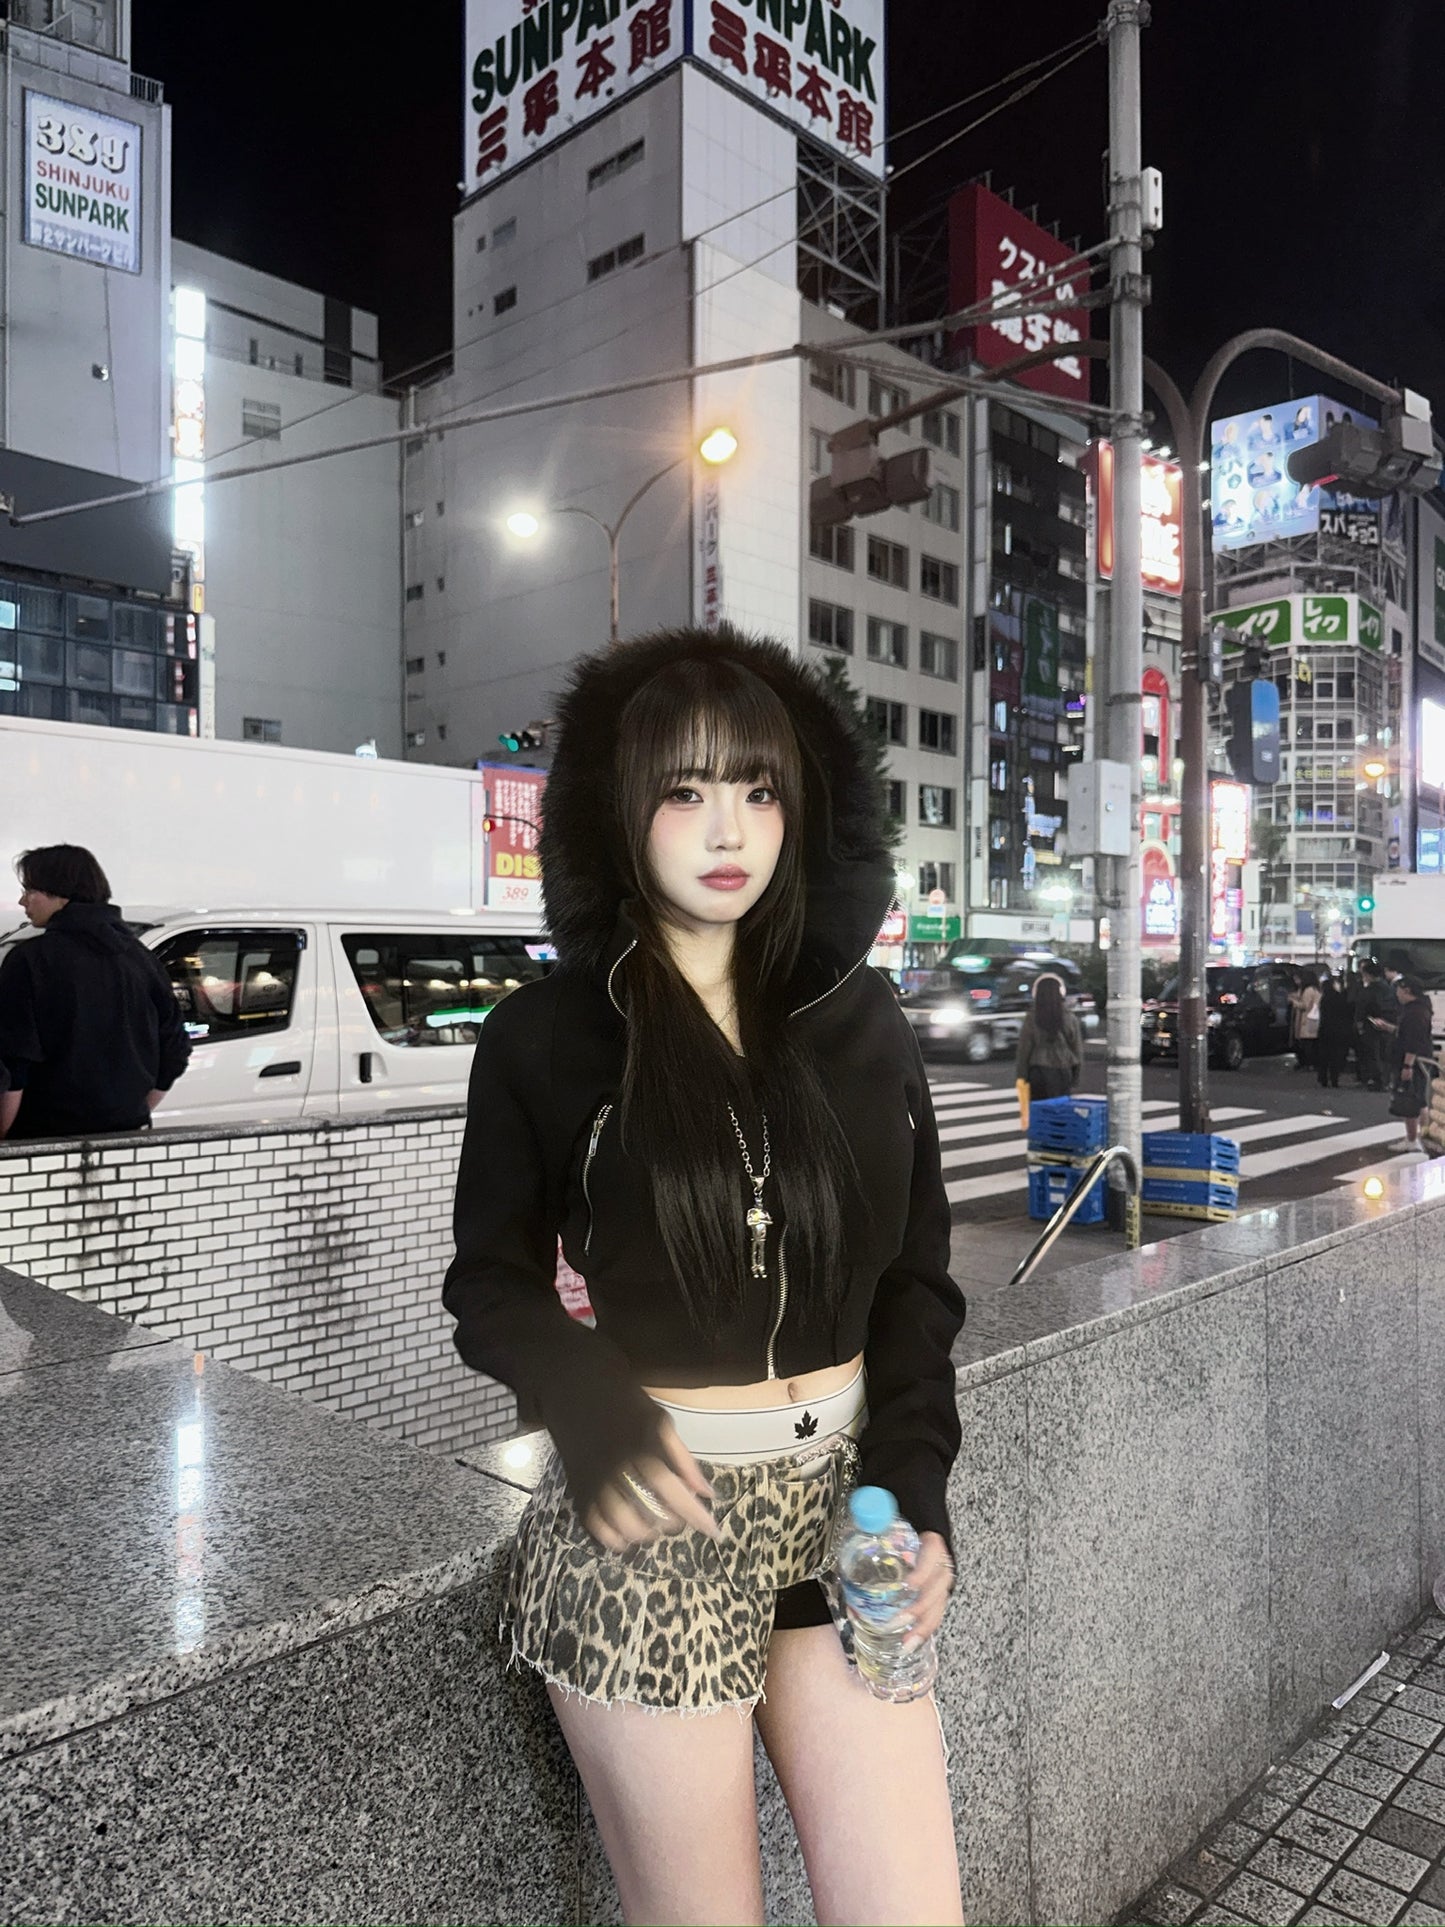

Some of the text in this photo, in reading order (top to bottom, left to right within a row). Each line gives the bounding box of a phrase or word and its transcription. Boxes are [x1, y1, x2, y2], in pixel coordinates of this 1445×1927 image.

[476, 0, 672, 177] 三平本館
[709, 0, 873, 158] 三平本館
[36, 115, 129, 173] 389
[36, 159, 130, 202] SHINJUKU
[35, 183, 130, 233] SUNPARK
[502, 886, 529, 900] 389
